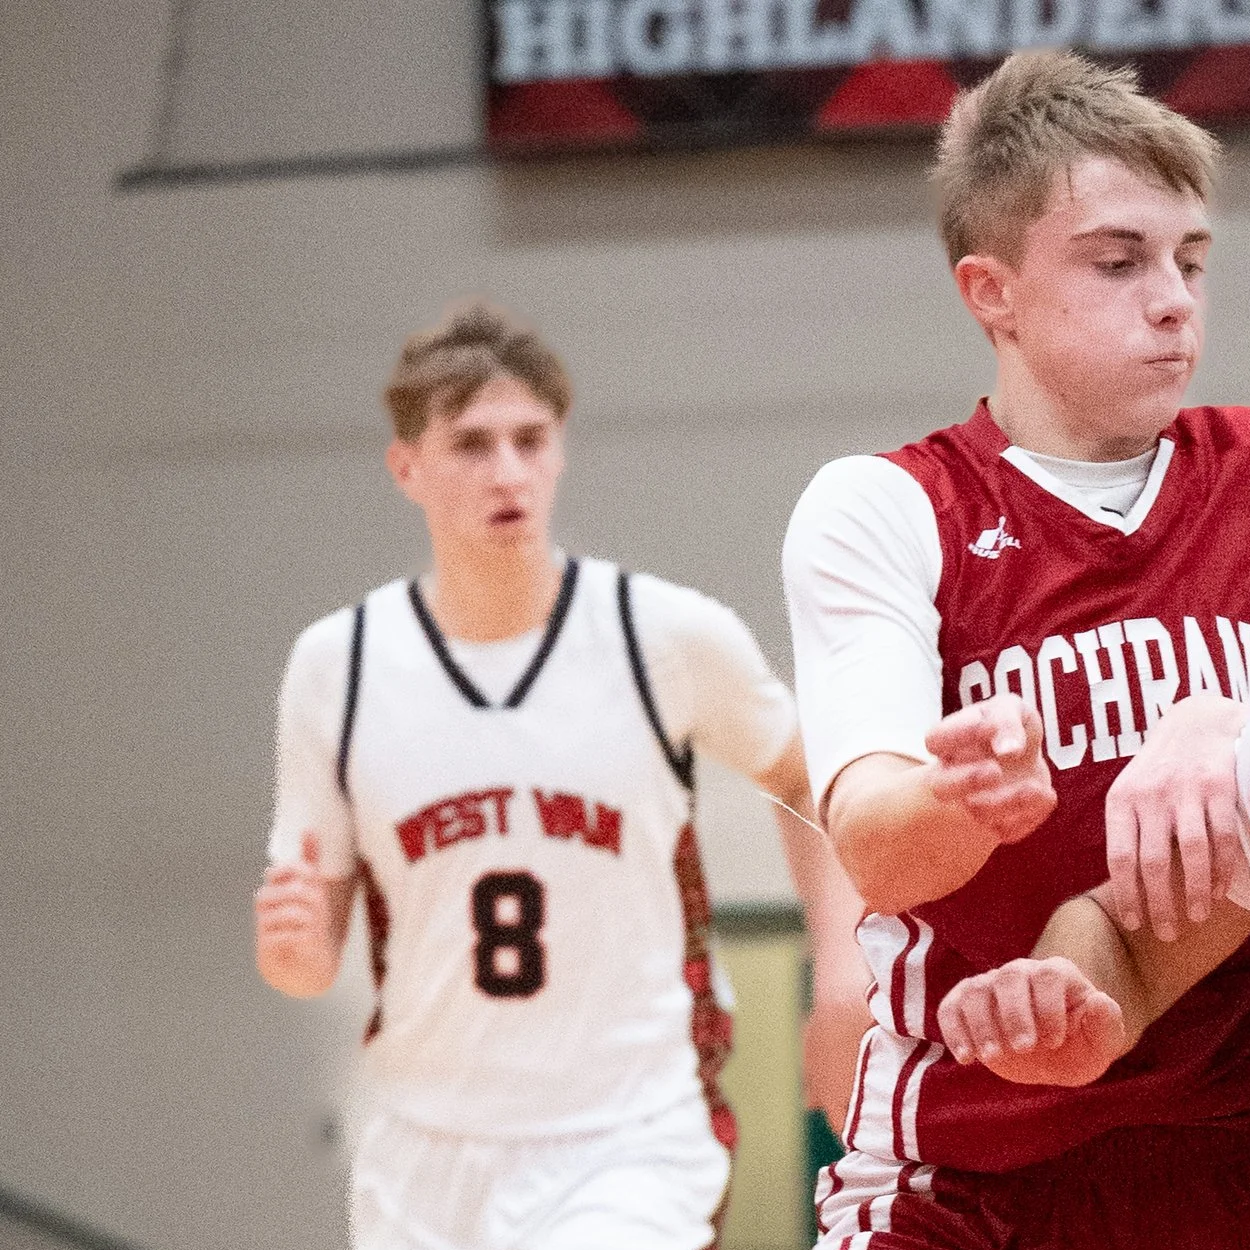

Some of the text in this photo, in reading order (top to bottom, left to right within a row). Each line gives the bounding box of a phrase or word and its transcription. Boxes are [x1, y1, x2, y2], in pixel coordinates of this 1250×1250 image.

[395, 786, 623, 862] WEST VAN
[470, 867, 548, 1000] 8
